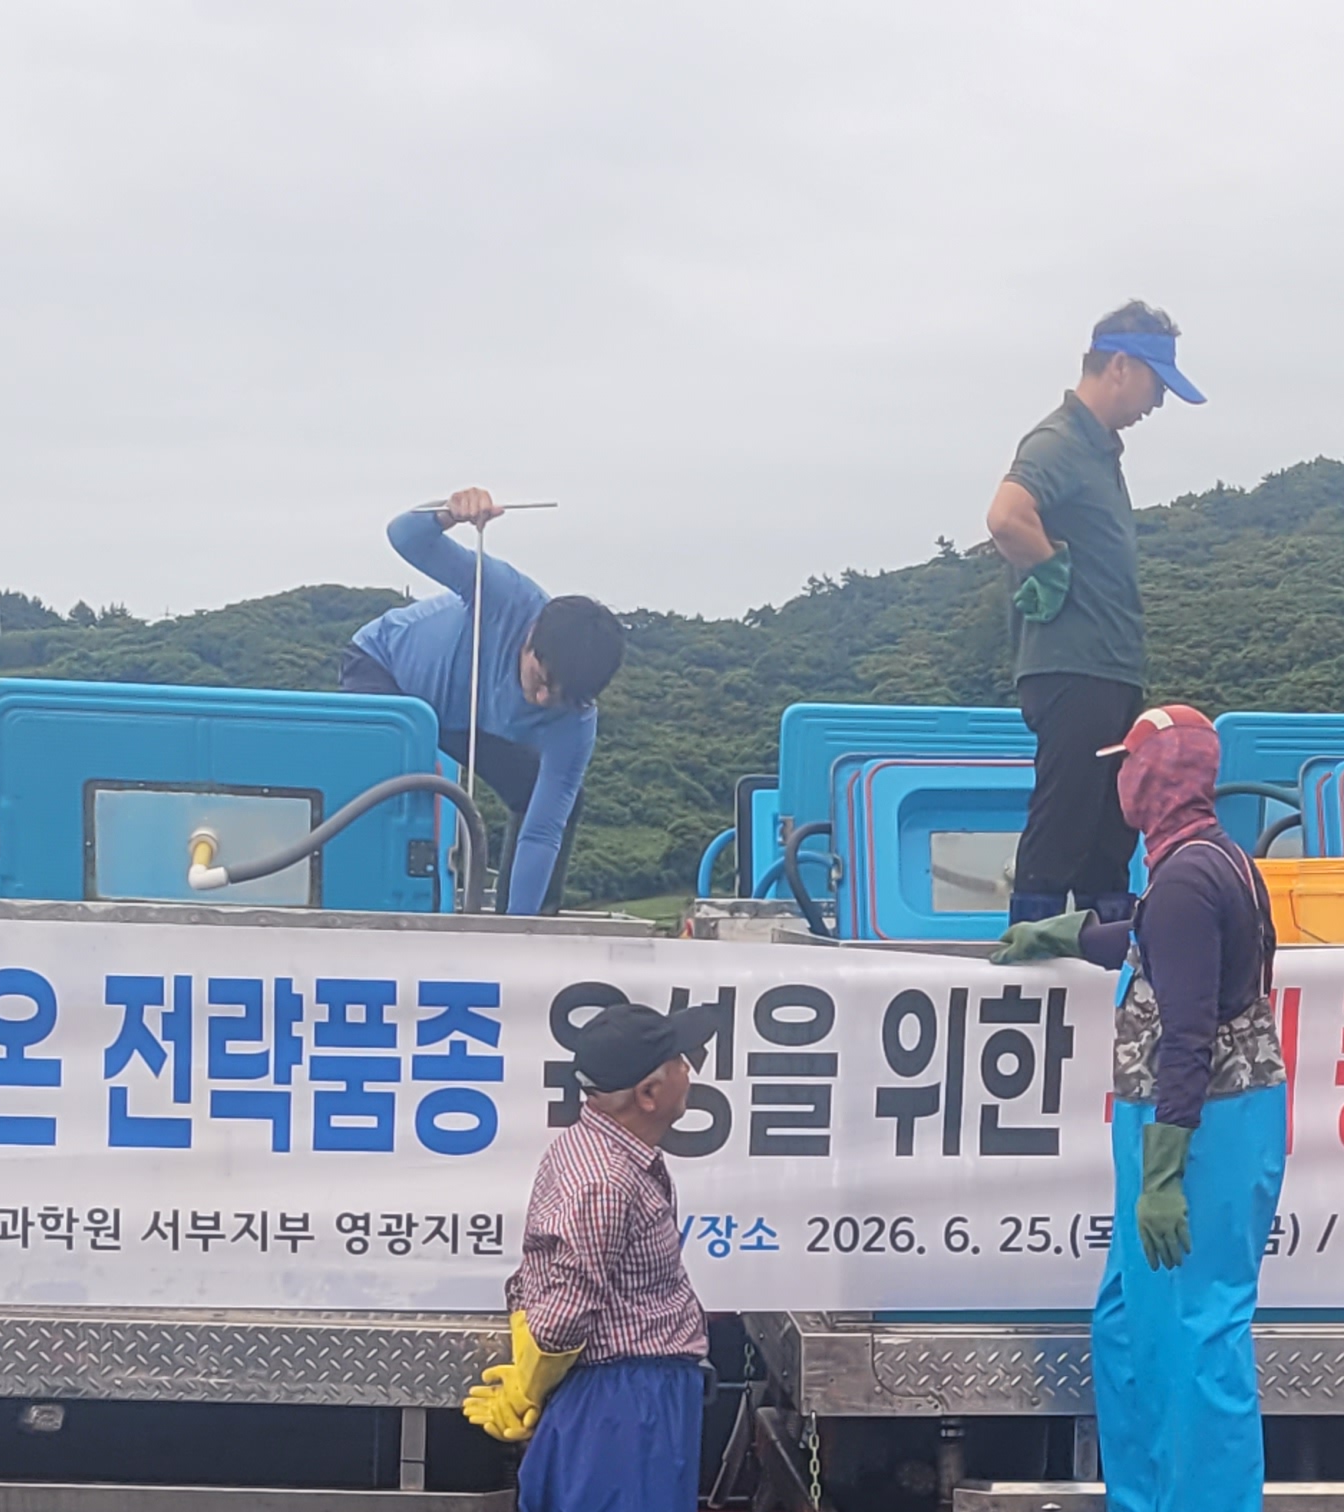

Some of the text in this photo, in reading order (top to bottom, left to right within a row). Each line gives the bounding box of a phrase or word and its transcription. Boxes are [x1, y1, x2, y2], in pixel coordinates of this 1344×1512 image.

[102, 974, 506, 1156] 전략품종
[875, 984, 1075, 1157] 위한
[141, 1209, 315, 1254] 서부지부
[335, 1212, 504, 1256] 영광지원
[806, 1216, 926, 1255] 2026.
[944, 1216, 980, 1255] 6.
